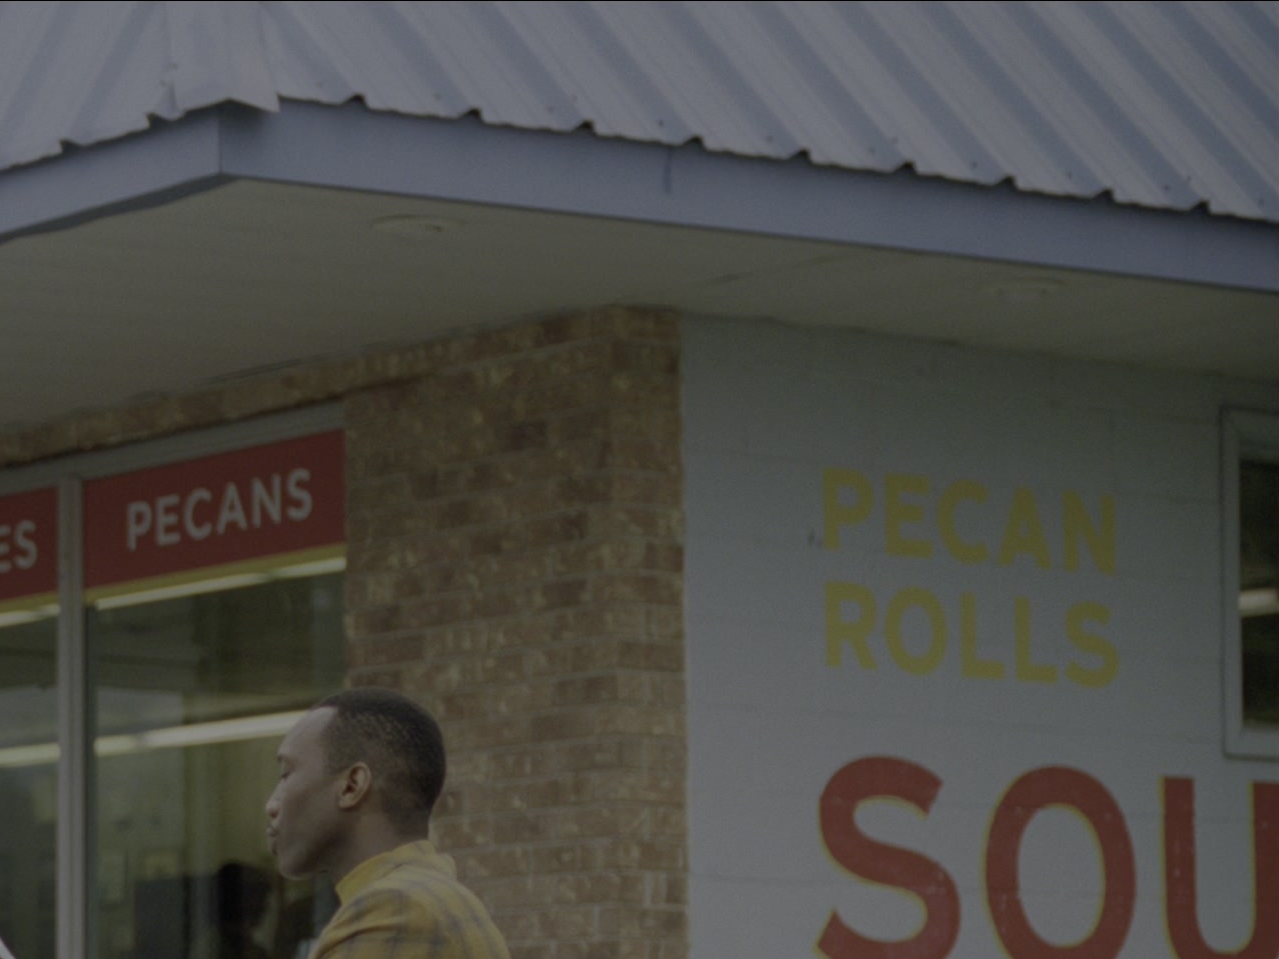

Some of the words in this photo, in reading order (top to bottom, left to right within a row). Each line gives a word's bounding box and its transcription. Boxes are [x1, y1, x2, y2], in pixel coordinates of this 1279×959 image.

[125, 468, 314, 551] PECANS
[821, 466, 1118, 576] PECAN
[823, 579, 1121, 688] ROLLS
